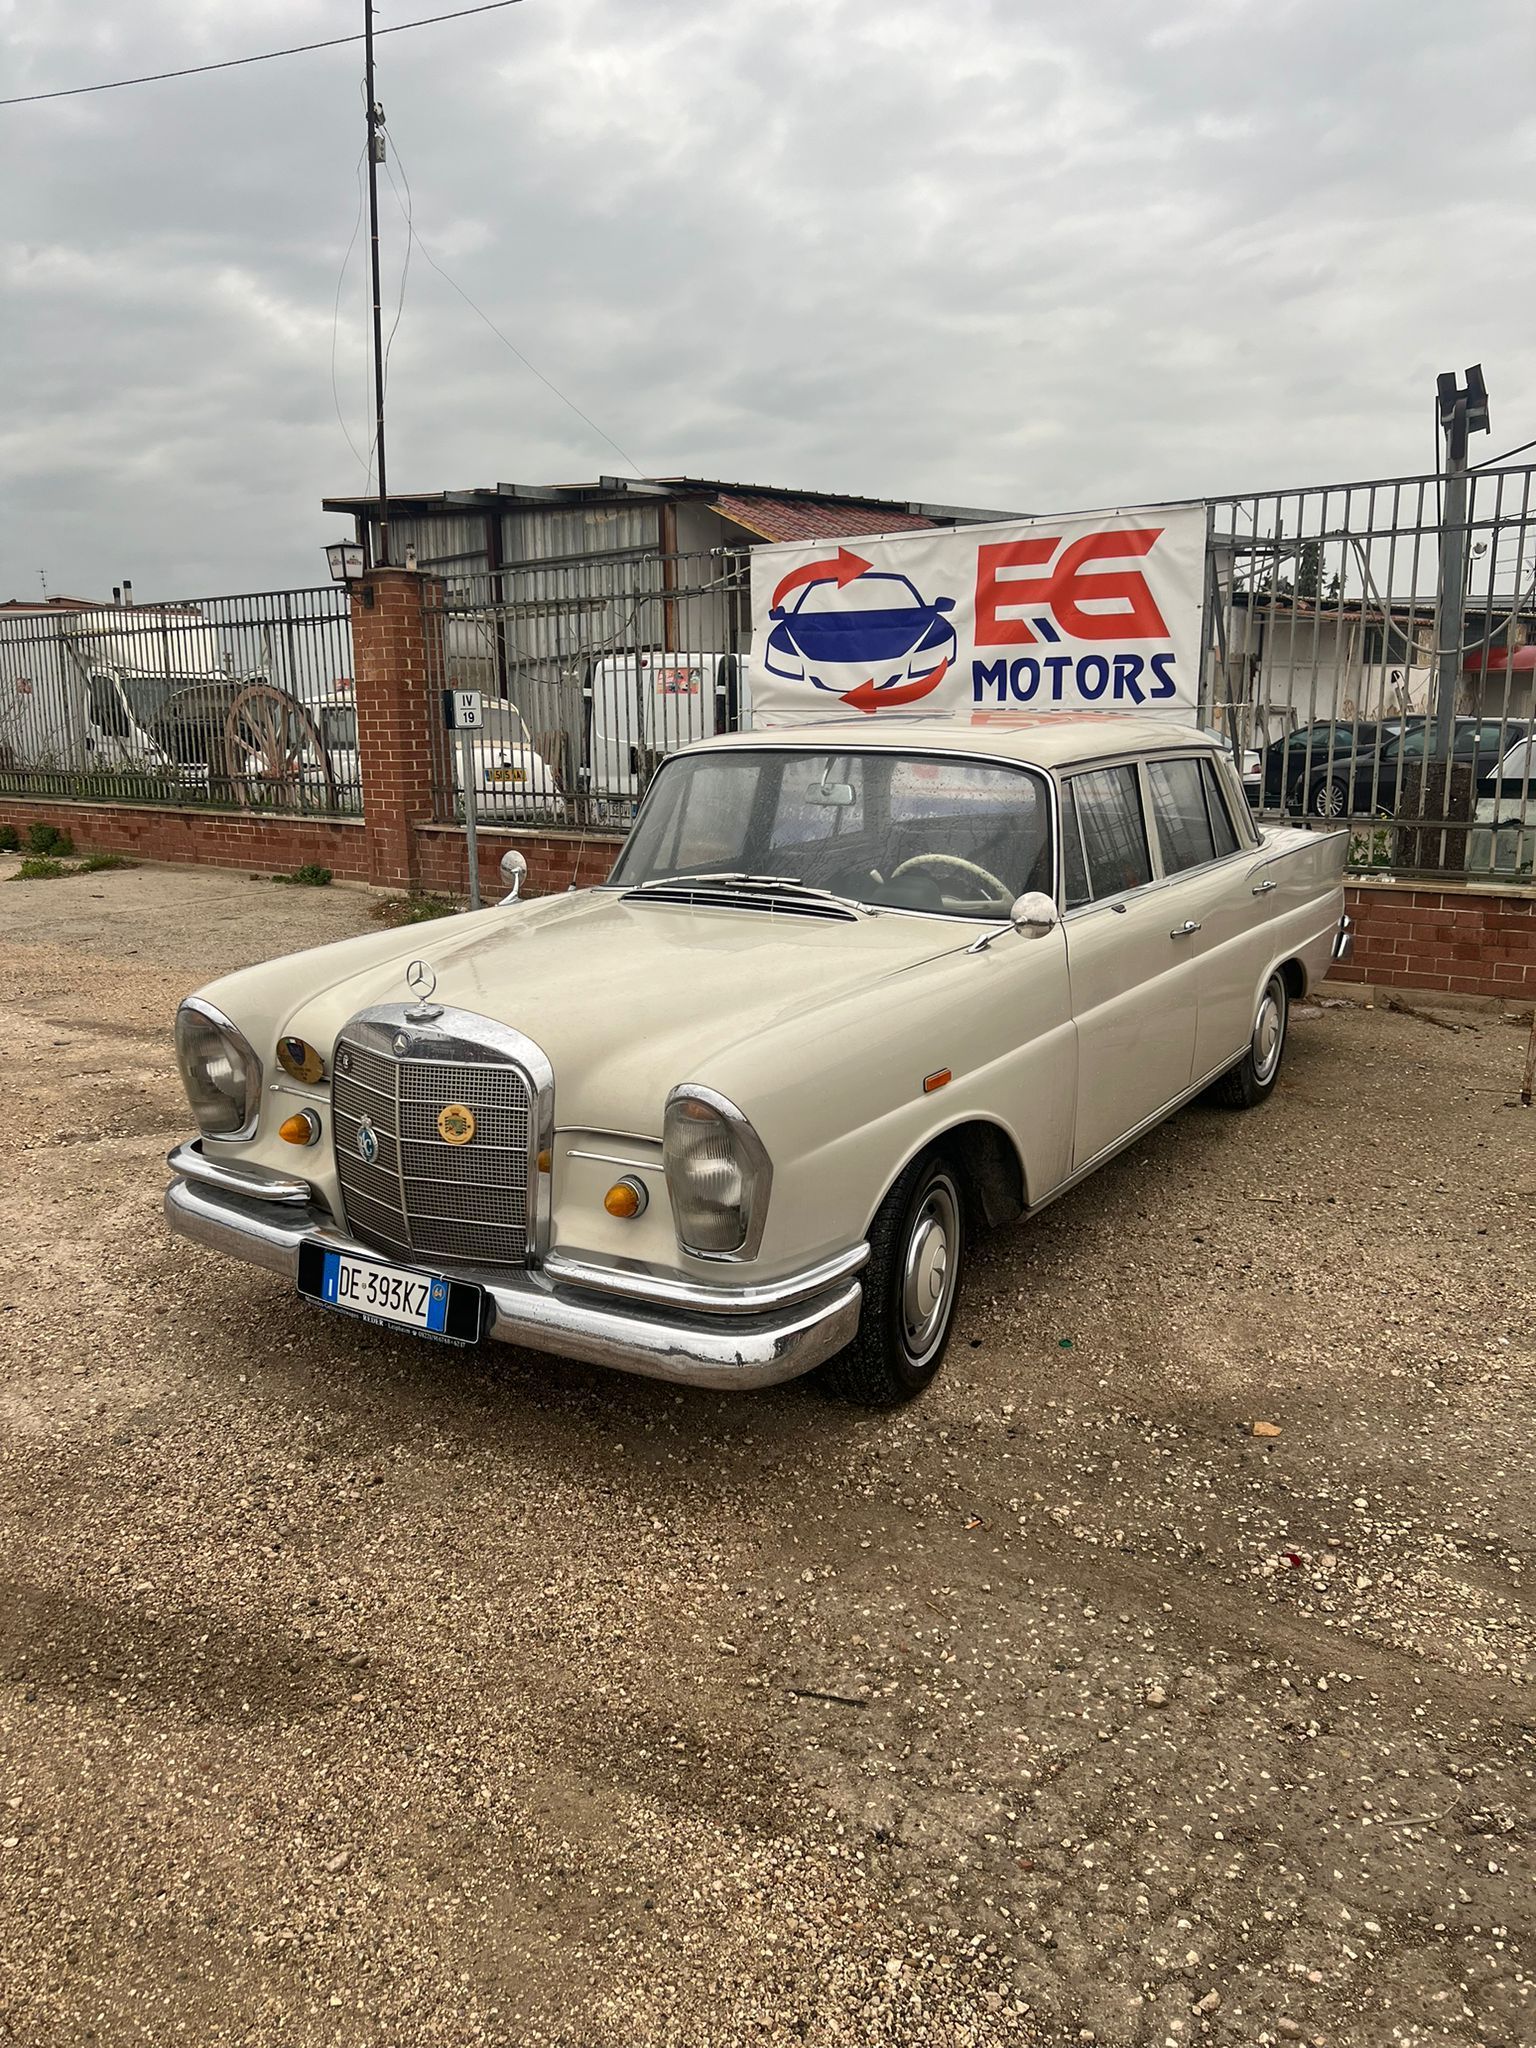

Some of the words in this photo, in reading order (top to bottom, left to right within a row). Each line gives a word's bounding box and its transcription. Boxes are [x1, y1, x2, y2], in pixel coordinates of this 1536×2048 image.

[972, 653, 1177, 705] MOTORS
[462, 694, 473, 707] IV
[463, 711, 475, 723] 19
